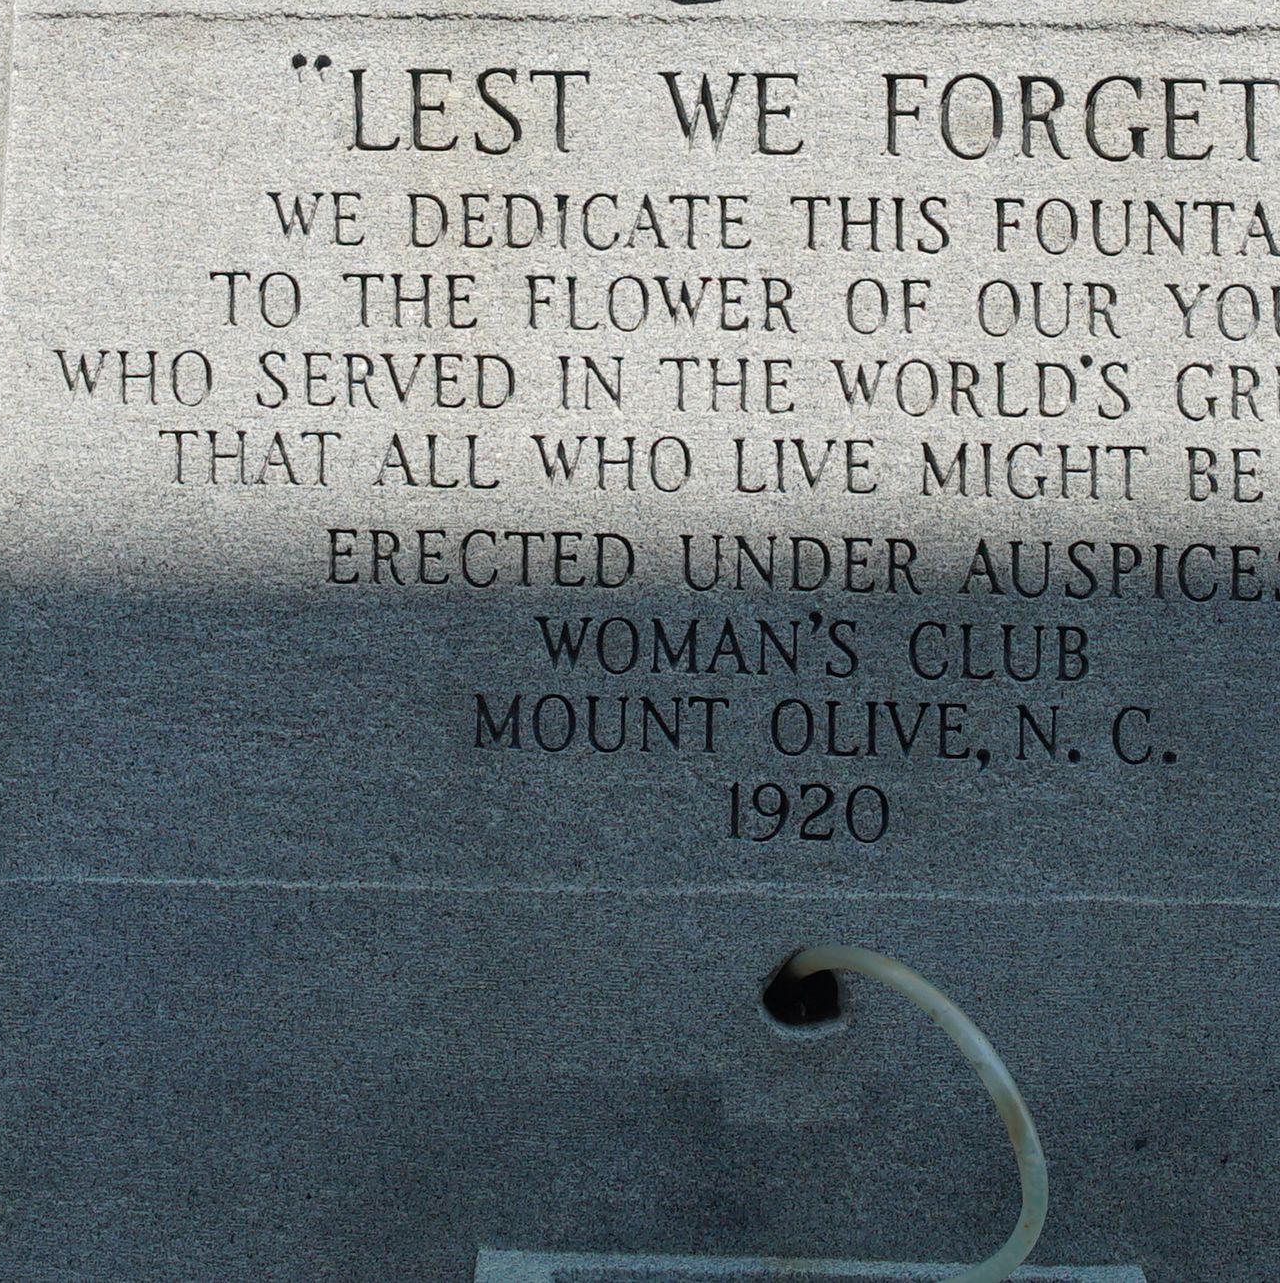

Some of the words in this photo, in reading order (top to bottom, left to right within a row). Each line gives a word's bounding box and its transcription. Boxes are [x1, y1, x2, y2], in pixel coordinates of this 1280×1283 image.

[657, 70, 805, 157] WE
[266, 191, 366, 247] WE
[407, 192, 752, 251] DEDICATE
[790, 195, 951, 255] THIS
[208, 271, 302, 329] TO
[341, 272, 480, 331] THE
[522, 274, 799, 334] FLOWER
[845, 276, 933, 336] OF
[976, 278, 1123, 340] OUR
[51, 349, 214, 407] WHO
[255, 350, 516, 410] SERVED
[557, 354, 626, 413] IN
[658, 356, 796, 415] THE
[830, 354, 1132, 421] WORLD'S
[158, 428, 342, 488] THAT
[370, 431, 502, 491] ALL
[528, 433, 694, 494] WHO
[732, 435, 879, 496] LIVE
[919, 440, 1149, 502] MIGHT
[1185, 446, 1265, 505] BE
[325, 527, 636, 589] ERECTED
[680, 534, 924, 595] UNDER
[534, 609, 863, 679] WOMAN'S
[908, 619, 1091, 683] CLUB
[471, 691, 730, 755] MOUNT
[769, 697, 992, 770] OLIVE,
[725, 780, 893, 845] 1920
